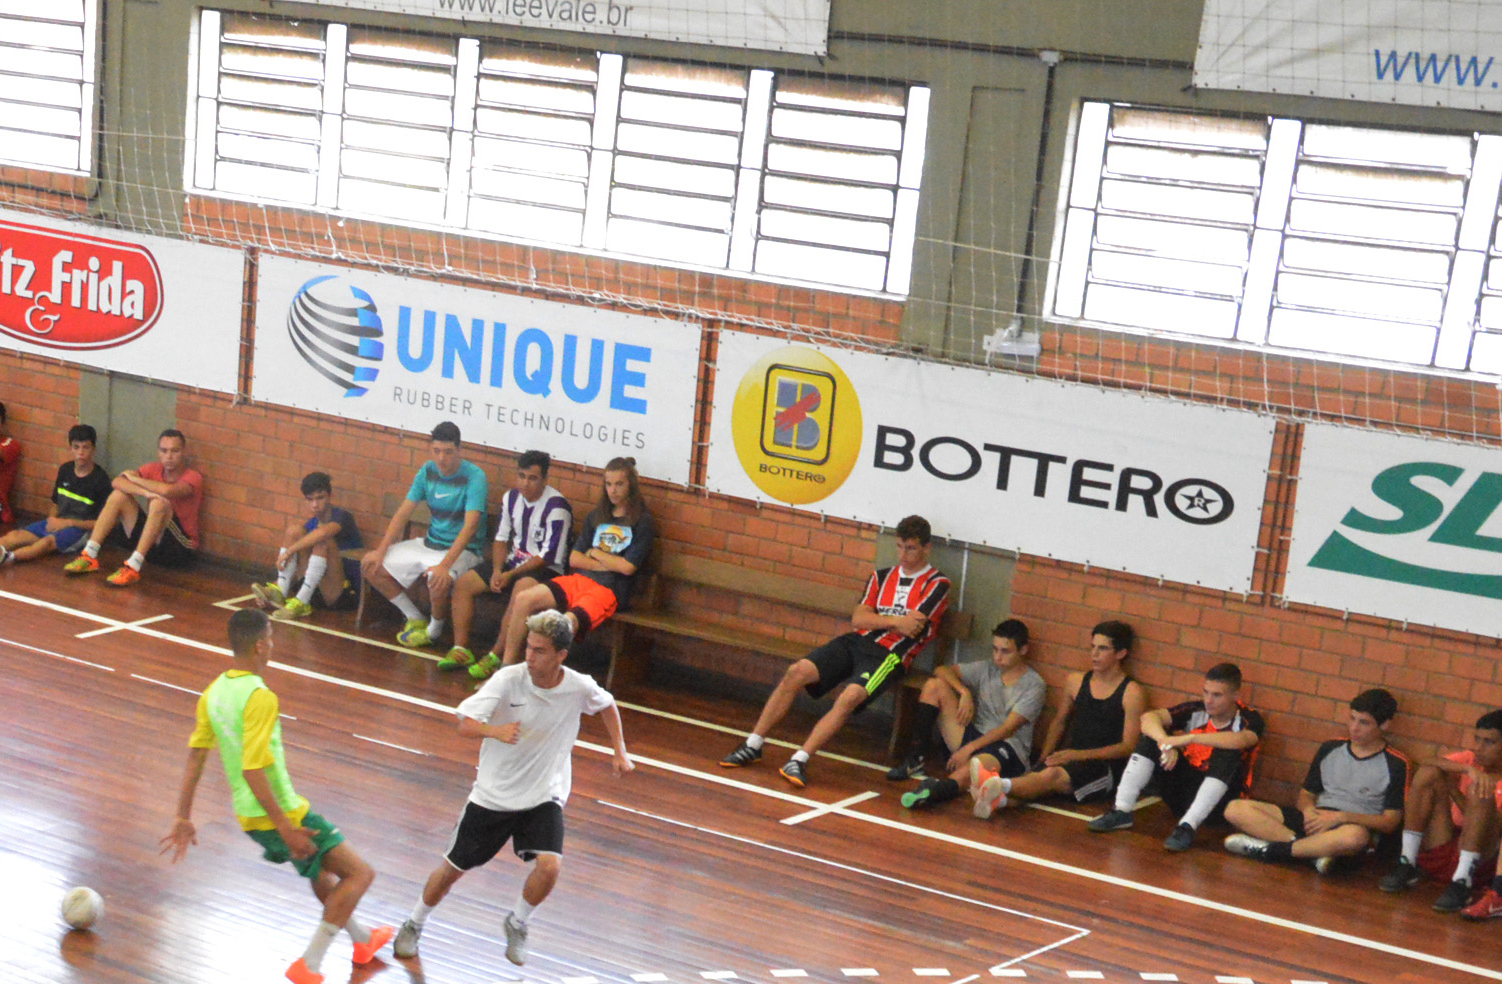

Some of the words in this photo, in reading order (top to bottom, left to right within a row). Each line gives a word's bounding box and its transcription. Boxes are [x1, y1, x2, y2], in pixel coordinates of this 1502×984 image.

[1374, 48, 1498, 89] www.
[24, 291, 61, 335] &
[50, 249, 145, 322] Frida
[396, 305, 653, 416] UNIQUE
[393, 385, 473, 417] RUBBER
[485, 403, 646, 450] TECHNOLOGIES
[759, 463, 827, 485] BOTTERO
[872, 424, 1235, 526] BOTTERO
